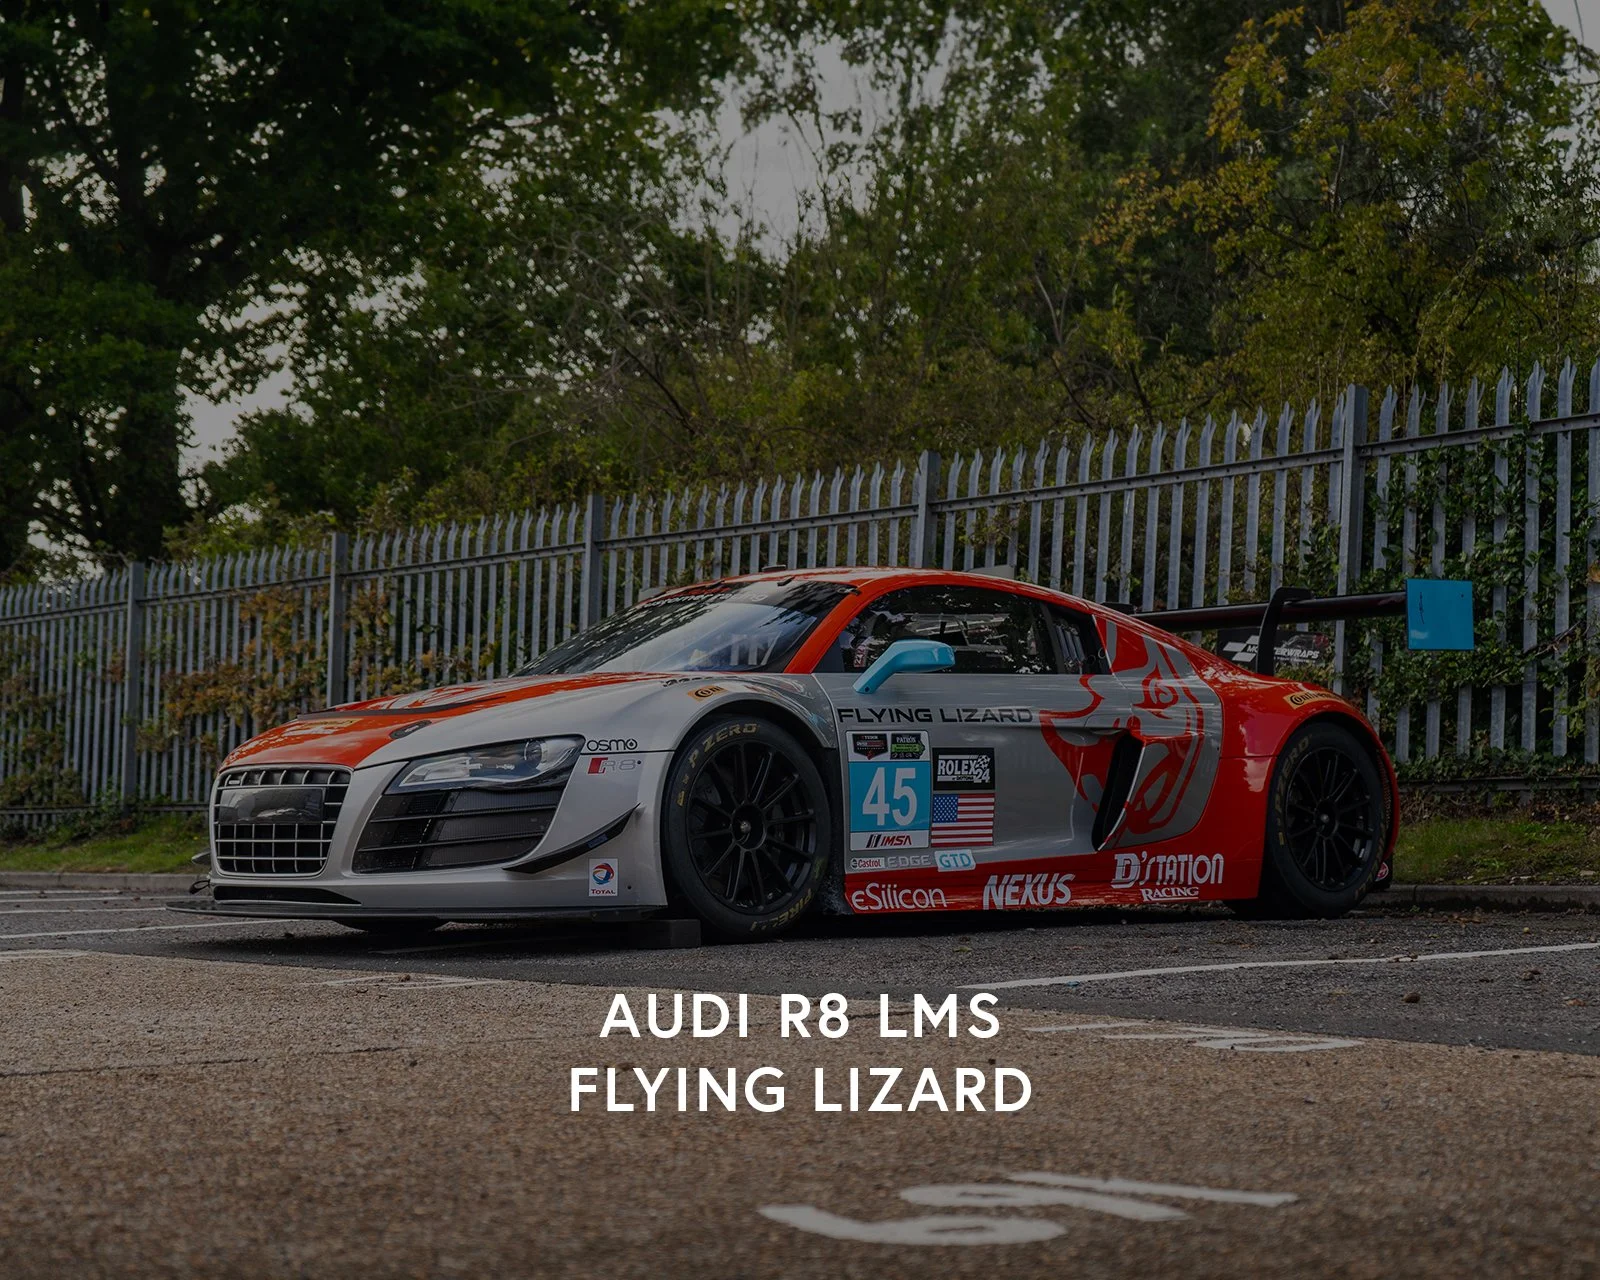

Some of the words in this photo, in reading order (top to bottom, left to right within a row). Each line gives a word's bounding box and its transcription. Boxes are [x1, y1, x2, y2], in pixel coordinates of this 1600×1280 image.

[837, 708, 933, 723] FLYING
[938, 708, 1032, 723] LIZARD
[702, 723, 758, 753] ZERO
[937, 760, 978, 776] ROLEX
[974, 768, 990, 784] 24
[862, 766, 918, 827] 45
[880, 835, 912, 846] IMSA
[858, 859, 881, 868] Castrol
[887, 855, 931, 867] EDGE
[939, 853, 971, 868] GTD
[851, 882, 948, 910] eSilicon
[983, 872, 1076, 910] NEXUS
[1140, 887, 1199, 902] RACING
